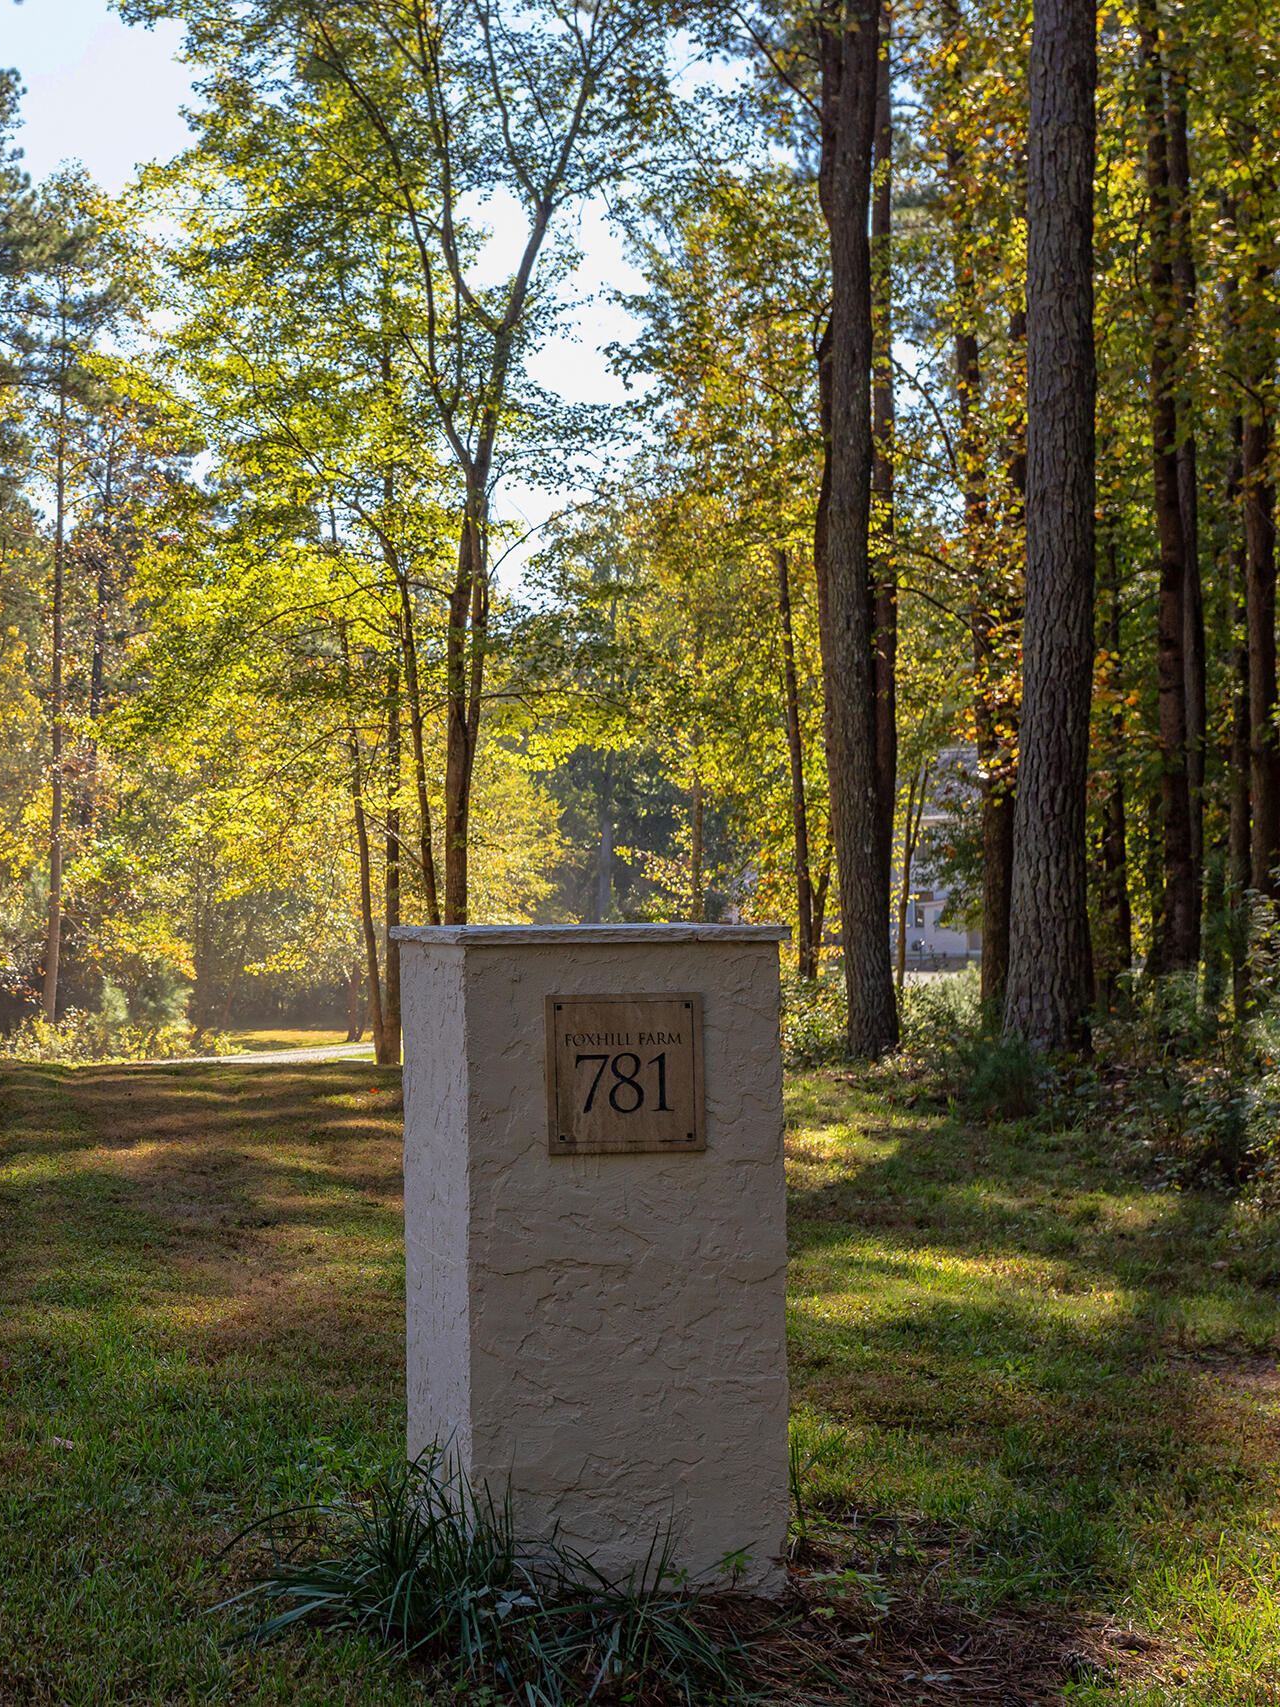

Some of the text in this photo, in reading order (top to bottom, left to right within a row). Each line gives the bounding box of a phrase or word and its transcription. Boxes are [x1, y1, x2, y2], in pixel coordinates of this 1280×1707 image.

[565, 1031, 683, 1047] FOXHILL FARM
[575, 1051, 675, 1114] 781
